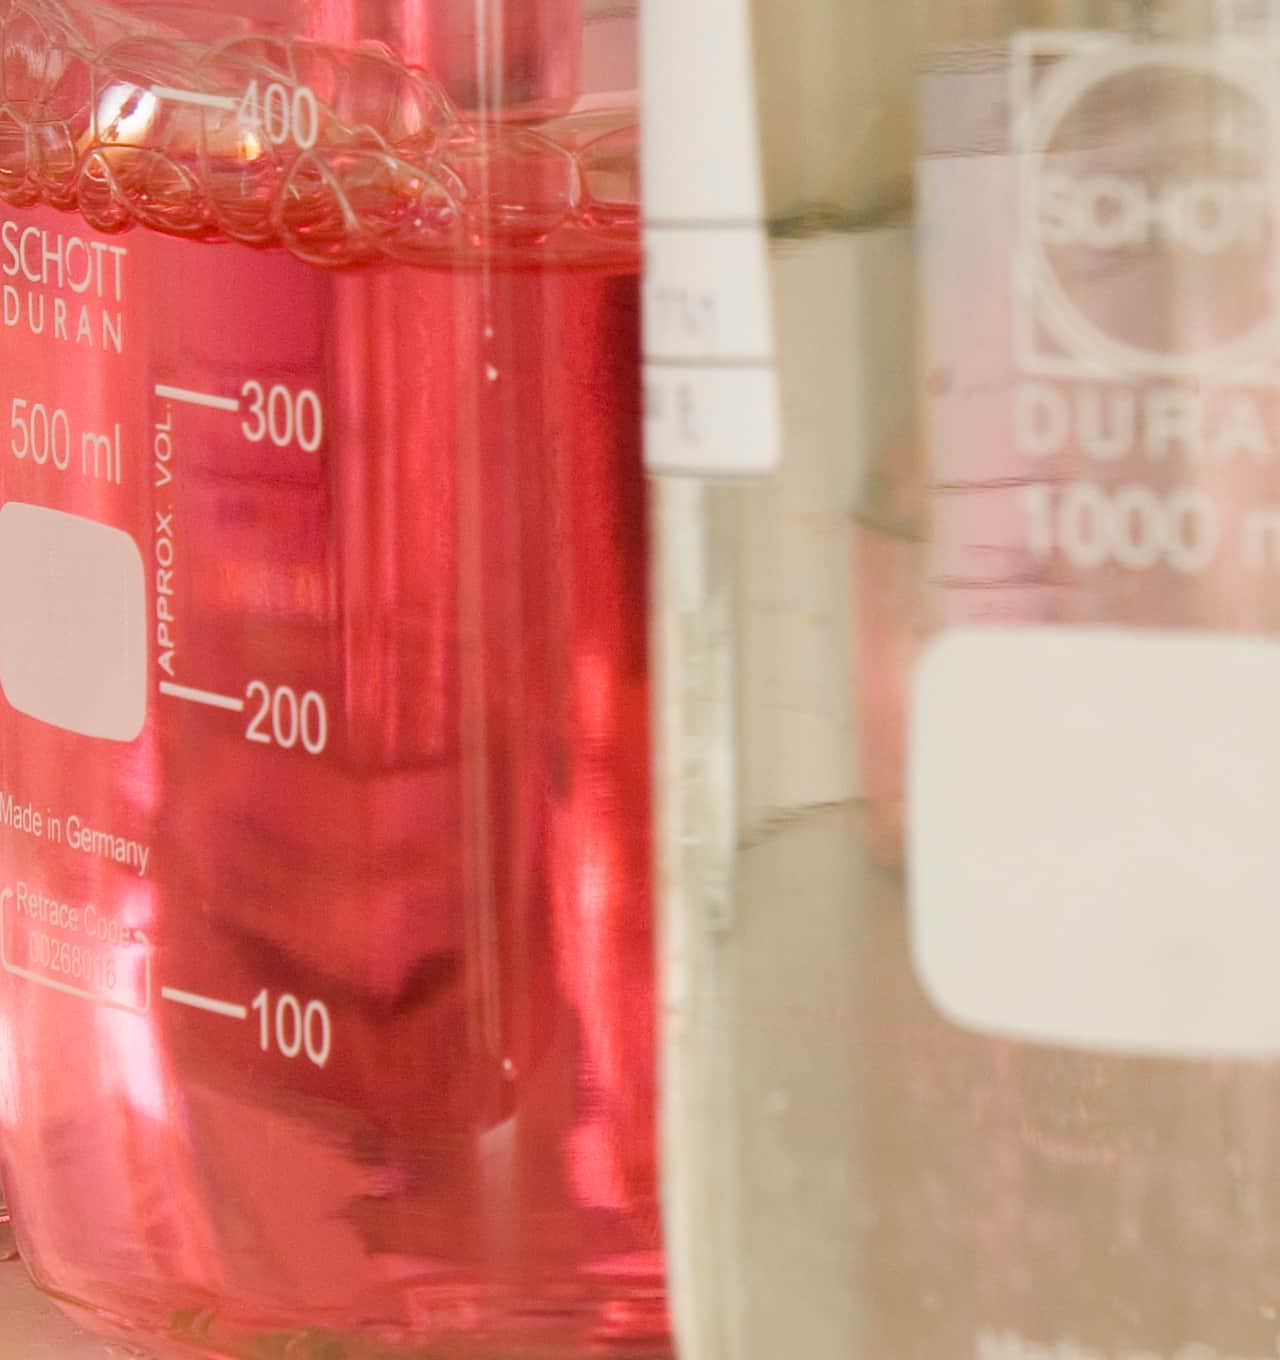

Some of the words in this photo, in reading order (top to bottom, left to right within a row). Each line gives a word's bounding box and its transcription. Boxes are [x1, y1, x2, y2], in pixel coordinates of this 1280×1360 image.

[237, 80, 319, 150] 400
[1, 220, 128, 302] SCHOTT
[3, 285, 123, 353] DURAN
[10, 397, 71, 470] 500
[81, 422, 122, 485] ml
[241, 380, 324, 453] 300
[1023, 484, 1220, 572] 1000
[156, 505, 176, 676] APPROX.
[245, 680, 327, 754] 200
[0, 792, 43, 837] Made
[47, 807, 63, 844] in
[66, 815, 149, 876] Germany
[16, 880, 78, 931] Retrace
[83, 904, 130, 947] Code
[251, 988, 332, 1068] 100
